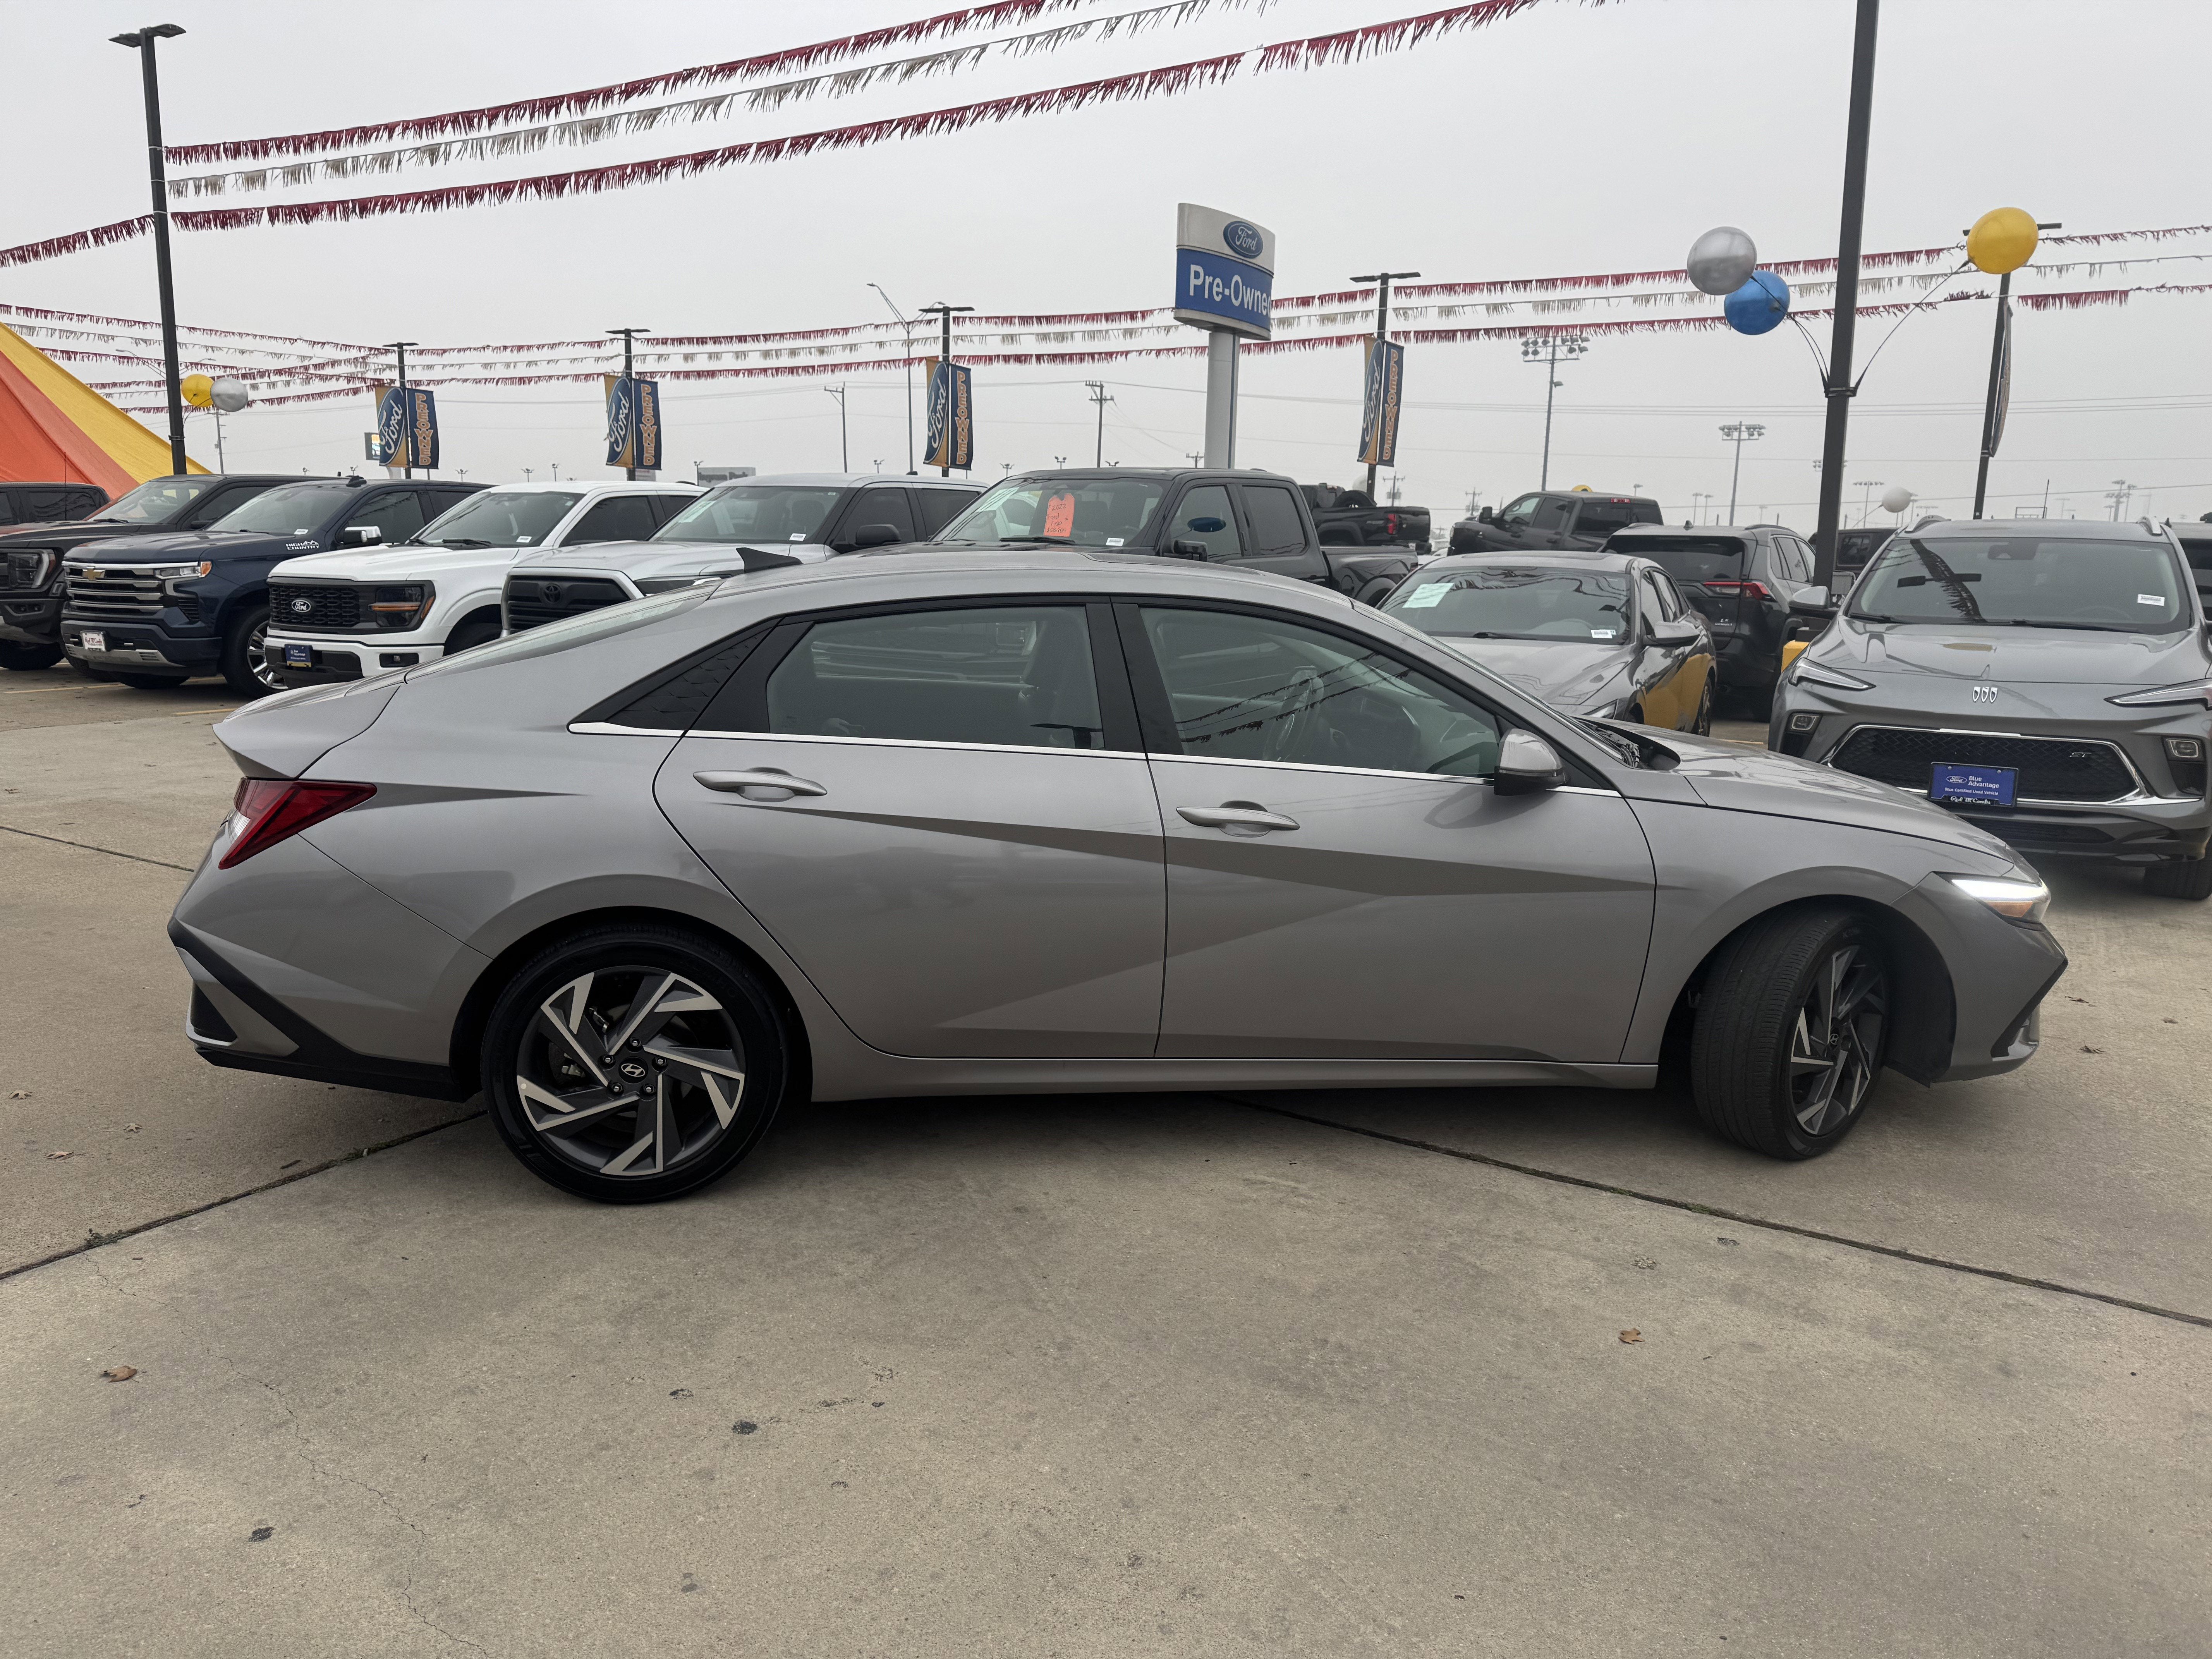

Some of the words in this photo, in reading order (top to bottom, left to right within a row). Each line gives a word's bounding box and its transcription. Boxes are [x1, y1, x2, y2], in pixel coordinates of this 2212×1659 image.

[1235, 227, 1257, 251] Ford
[379, 399, 403, 454] Ford
[414, 392, 434, 465] PREOWNED
[609, 390, 629, 453] Ford
[639, 384, 658, 465] PREOWNED
[927, 378, 946, 448] Ford
[955, 370, 970, 465] PREOWNED
[1363, 359, 1381, 442] Ford
[1382, 349, 1399, 460] PREOWNED
